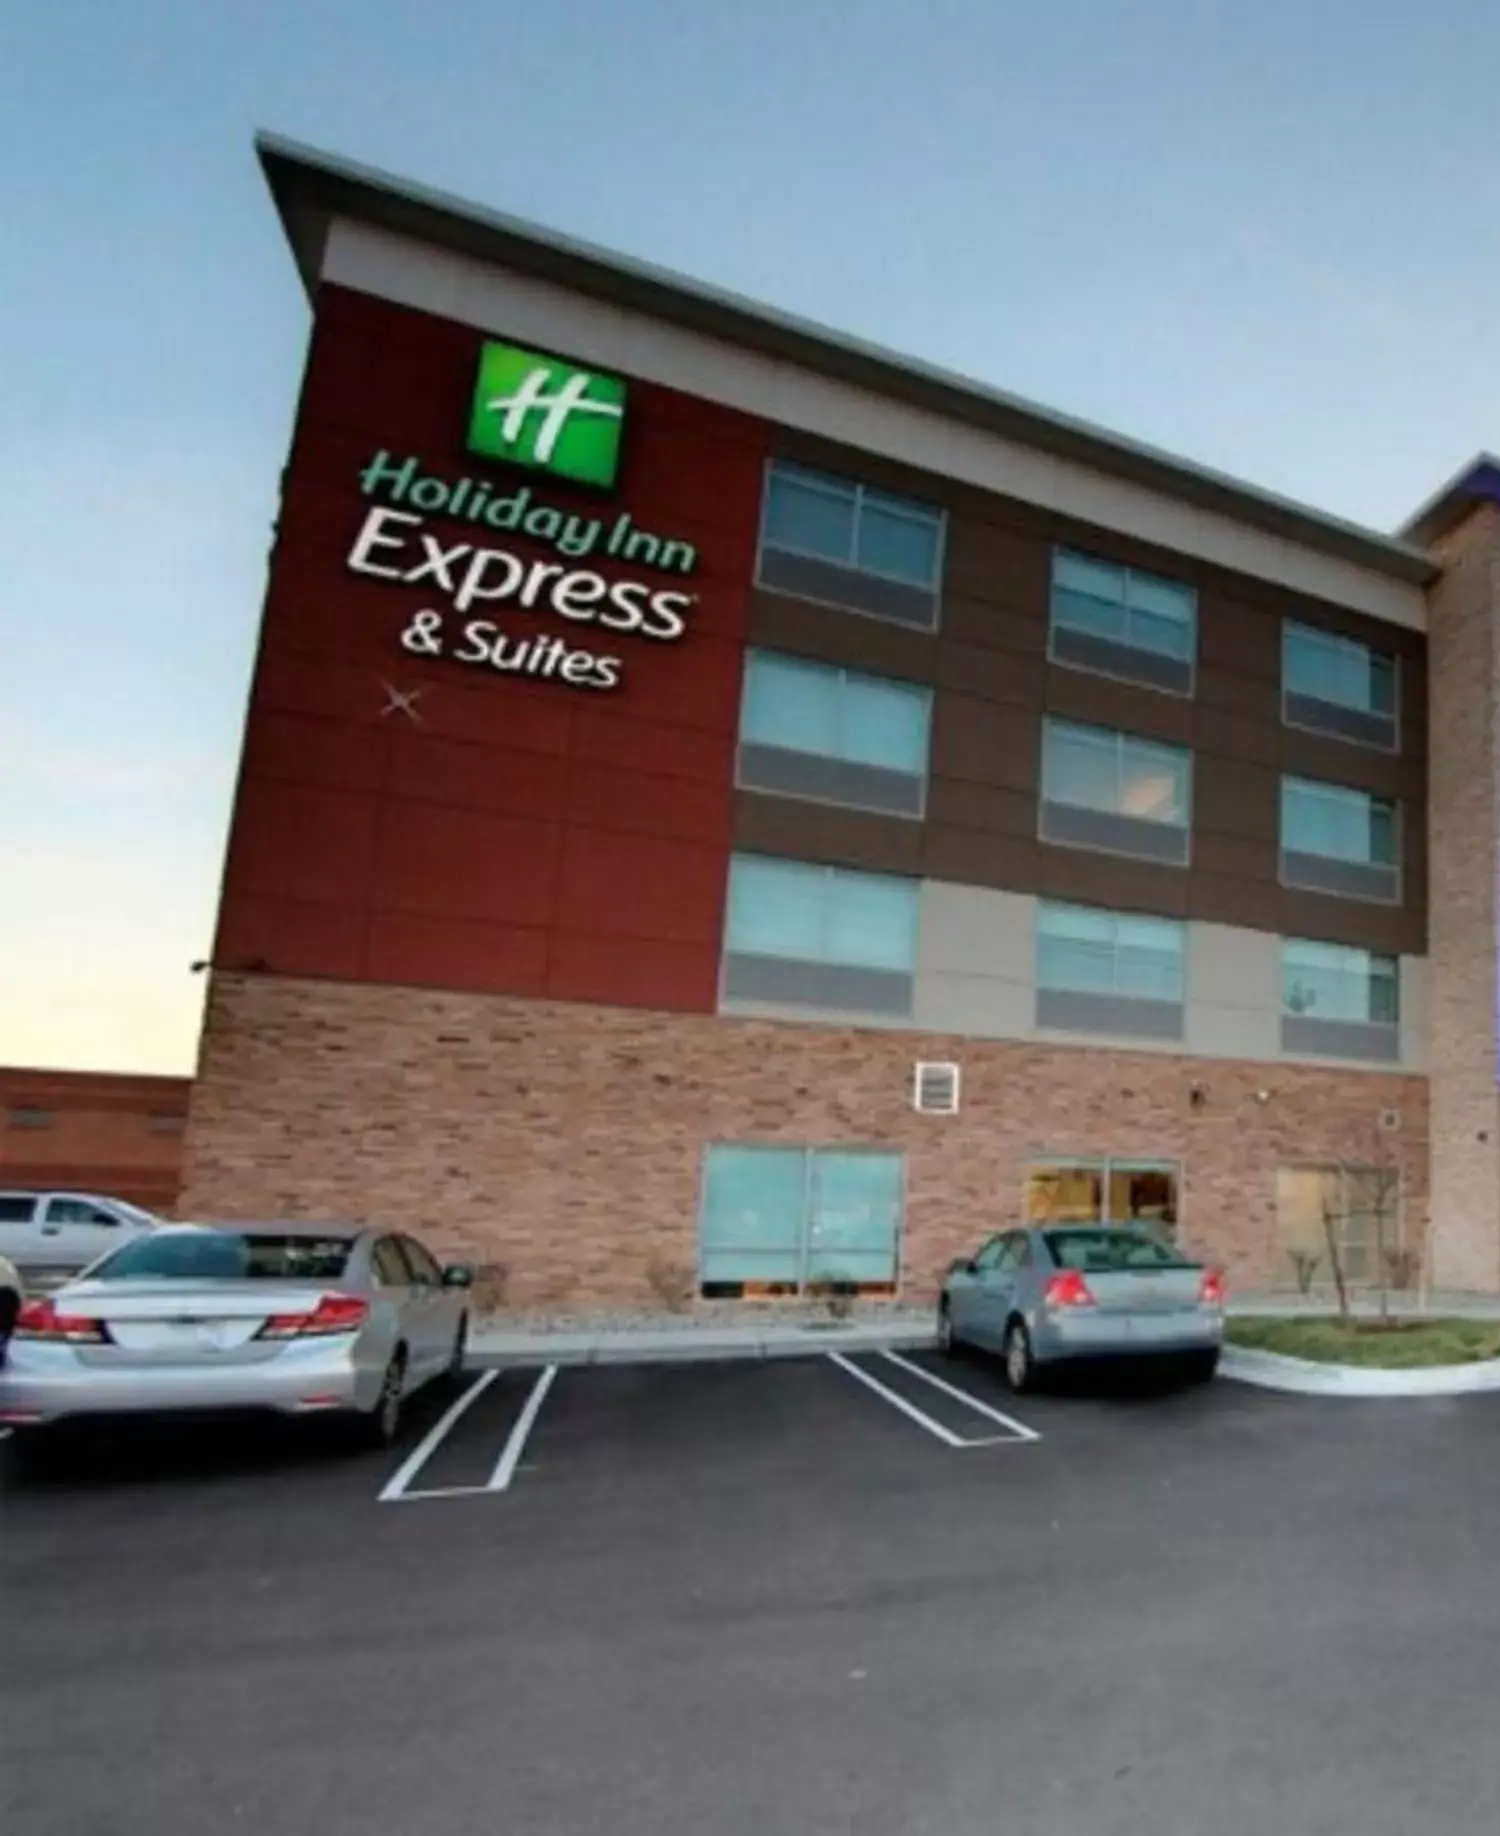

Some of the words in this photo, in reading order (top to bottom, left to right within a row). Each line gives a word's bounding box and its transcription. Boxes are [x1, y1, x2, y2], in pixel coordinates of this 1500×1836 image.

[347, 506, 692, 640] Express
[359, 449, 603, 557] Holiday
[607, 513, 697, 573] Inn
[401, 609, 443, 655] &
[454, 620, 622, 688] Suites
